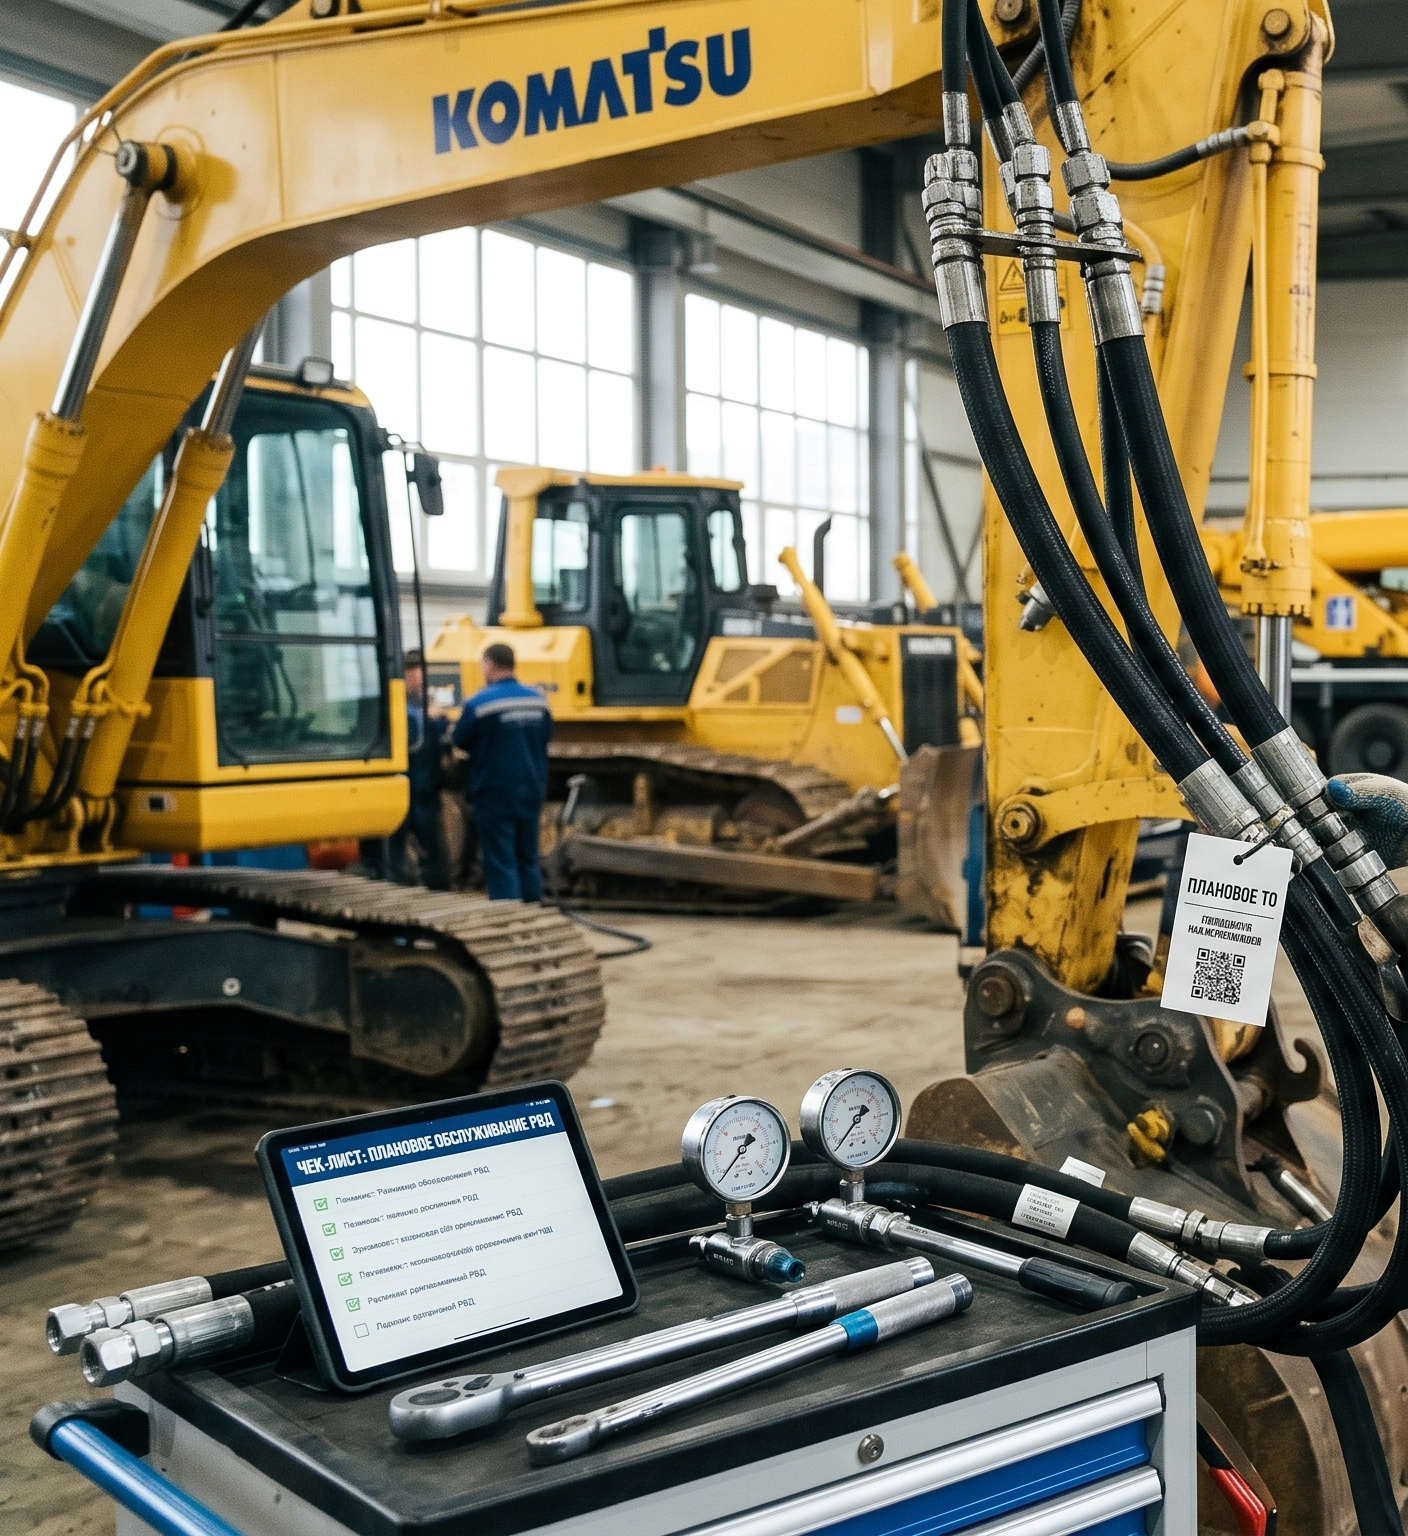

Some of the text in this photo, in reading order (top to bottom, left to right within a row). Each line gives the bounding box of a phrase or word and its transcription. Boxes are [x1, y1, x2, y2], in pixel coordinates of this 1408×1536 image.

[432, 26, 752, 155] KOMATSU
[1187, 877, 1278, 907] ПЛАНОВОЕ ТО
[297, 1112, 555, 1175] ЧЕК-ЛИСТ: ПЛАНОВОЕ ОБСЛУЖИВАНИЕ РВД
